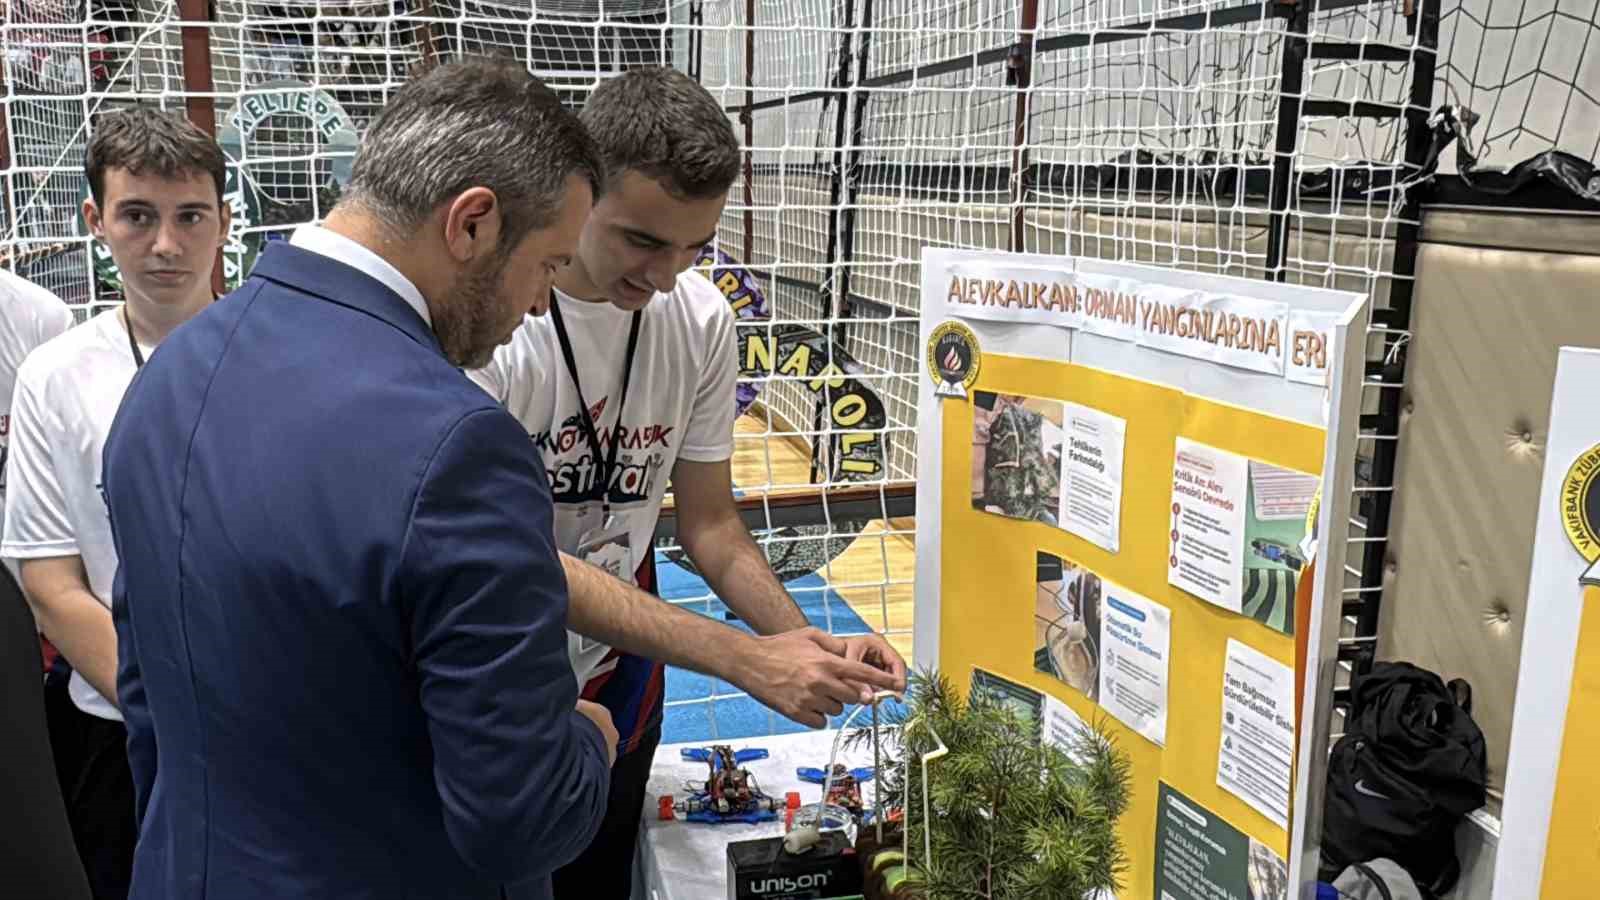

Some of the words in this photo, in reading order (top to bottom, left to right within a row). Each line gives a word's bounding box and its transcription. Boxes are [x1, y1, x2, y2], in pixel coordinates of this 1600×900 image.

[231, 90, 343, 138] KELTEPE
[948, 275, 1082, 313] ALEVKALKAN:
[1084, 287, 1137, 326] ORMAN
[1139, 299, 1281, 357] YANGINLARINA
[1566, 476, 1591, 550] VAKIFBANK
[750, 874, 827, 893] unison
